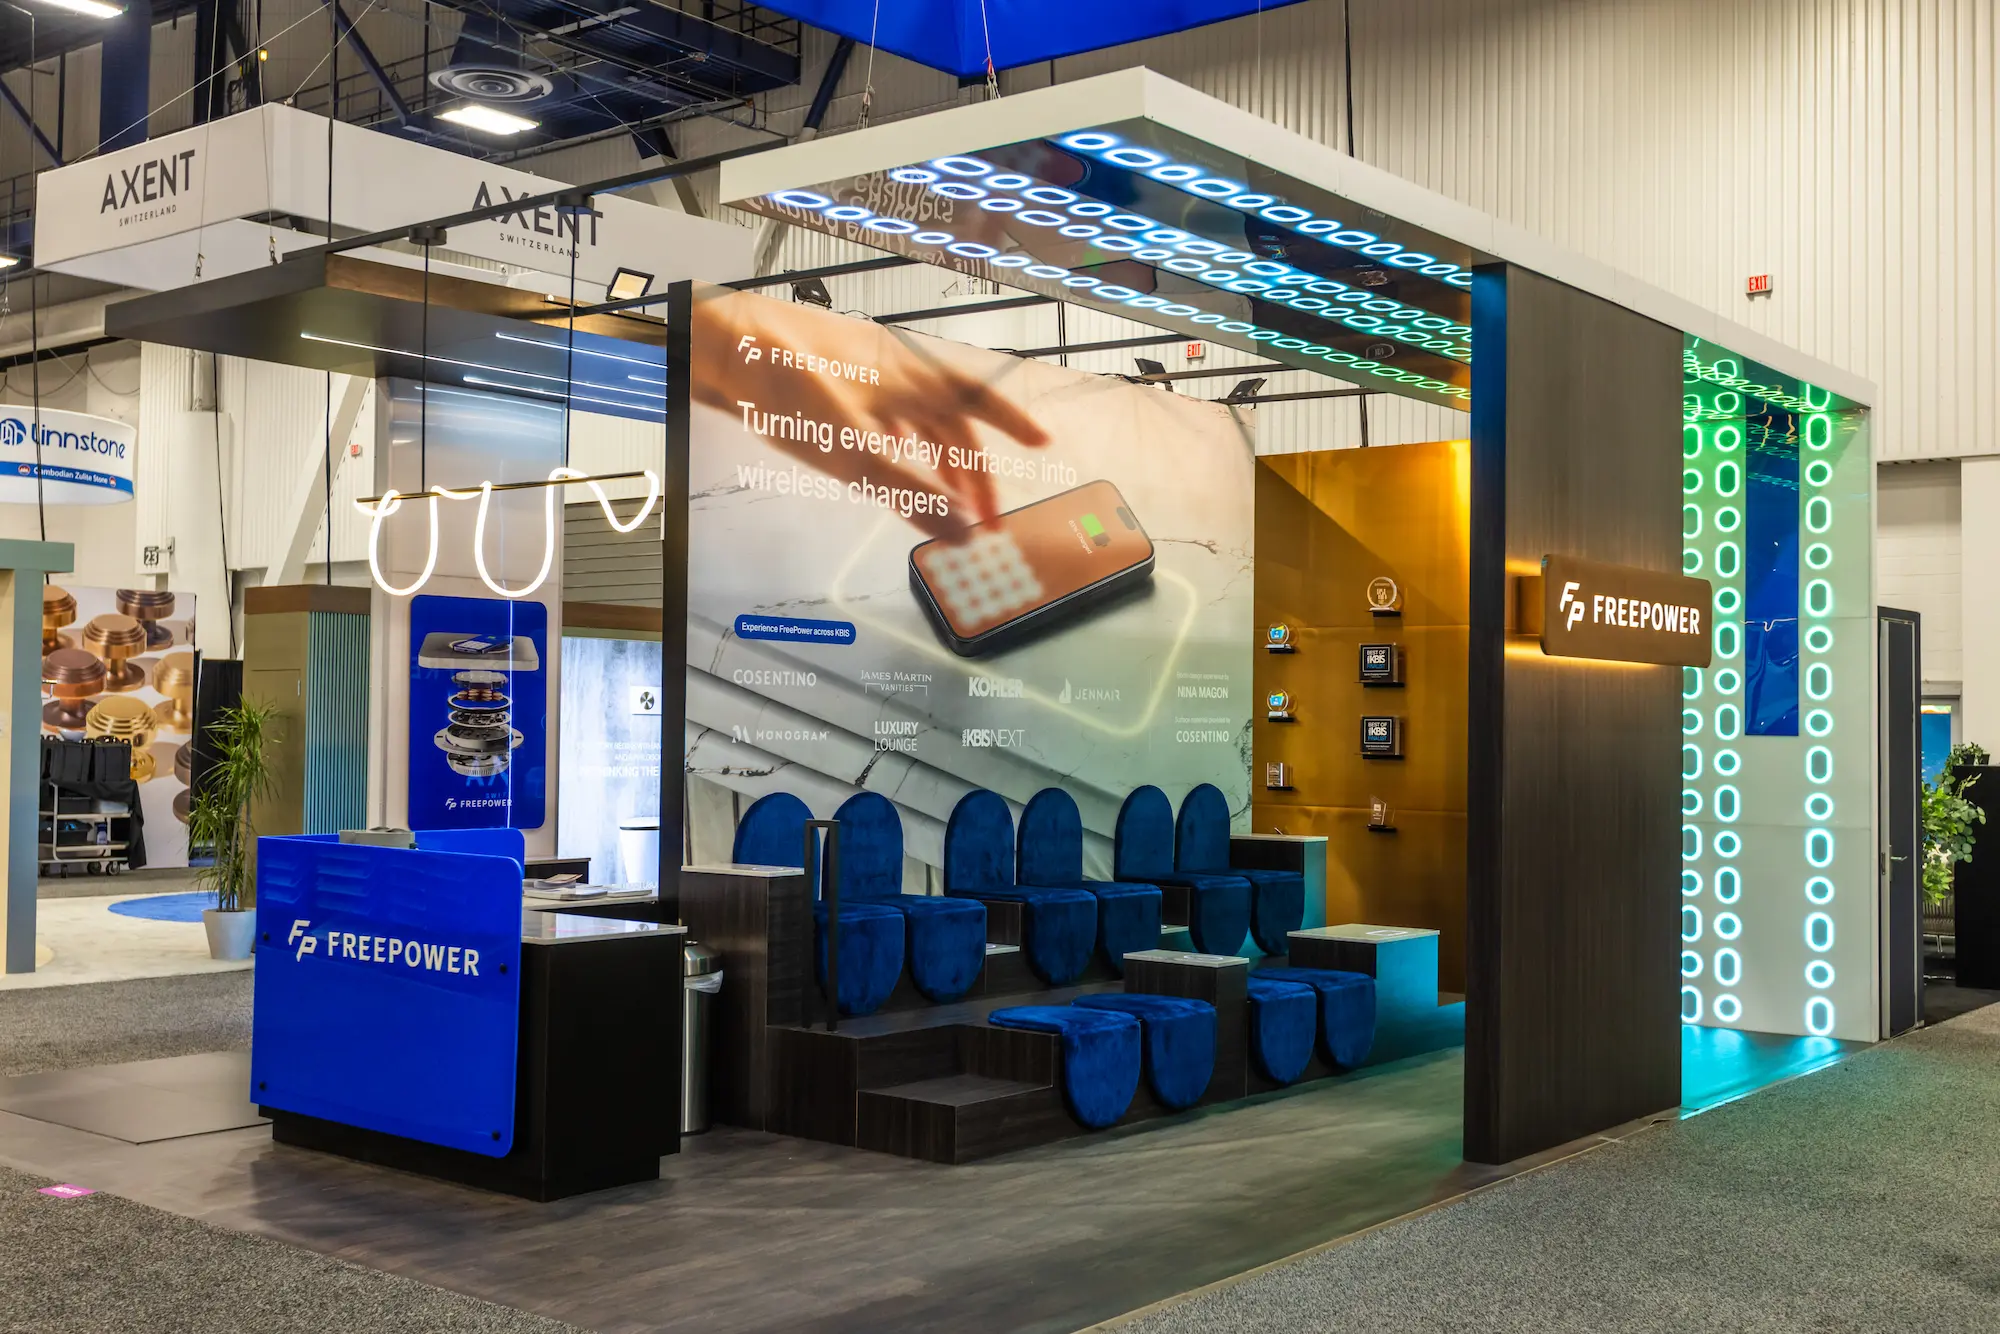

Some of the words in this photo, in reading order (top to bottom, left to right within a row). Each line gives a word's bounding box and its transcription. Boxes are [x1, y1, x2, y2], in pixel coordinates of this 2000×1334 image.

[100, 149, 195, 214] AXENT
[119, 204, 177, 227] SWITZERLAND
[472, 180, 603, 246] AXENT
[499, 233, 580, 259] SWITZERLAND
[1749, 274, 1768, 291] EXIT
[1187, 343, 1201, 356] EXIT
[771, 347, 880, 386] FREEPOWER
[737, 400, 833, 453] Turning
[840, 426, 943, 470] everyday
[948, 443, 1036, 479] surfaces
[1041, 456, 1077, 486] into
[737, 461, 841, 501] wireless
[848, 476, 949, 518] chargers
[145, 551, 158, 565] 23
[1594, 594, 1701, 635] FREEPOWER
[741, 621, 779, 633] Experience
[779, 624, 813, 636] FreePower
[813, 628, 834, 637] across
[835, 628, 850, 637] KBIS
[733, 669, 817, 687] COSENTINO
[860, 669, 891, 681] JAMES
[893, 671, 932, 683] MARTIN
[880, 684, 914, 692] VANITIES
[968, 677, 1024, 698] KOHLER
[1075, 688, 1121, 701] JENNAIR
[1177, 686, 1198, 698] NINA
[1199, 686, 1229, 699] MAGON
[756, 730, 827, 741] MONOGRAM
[874, 721, 919, 735] LUXURY
[874, 737, 918, 751] LOUNGE
[1176, 730, 1230, 743] COSENTINO
[641, 765, 660, 777] THE
[460, 799, 512, 808] FREEPOWER
[327, 931, 480, 976] FREEPOWER
